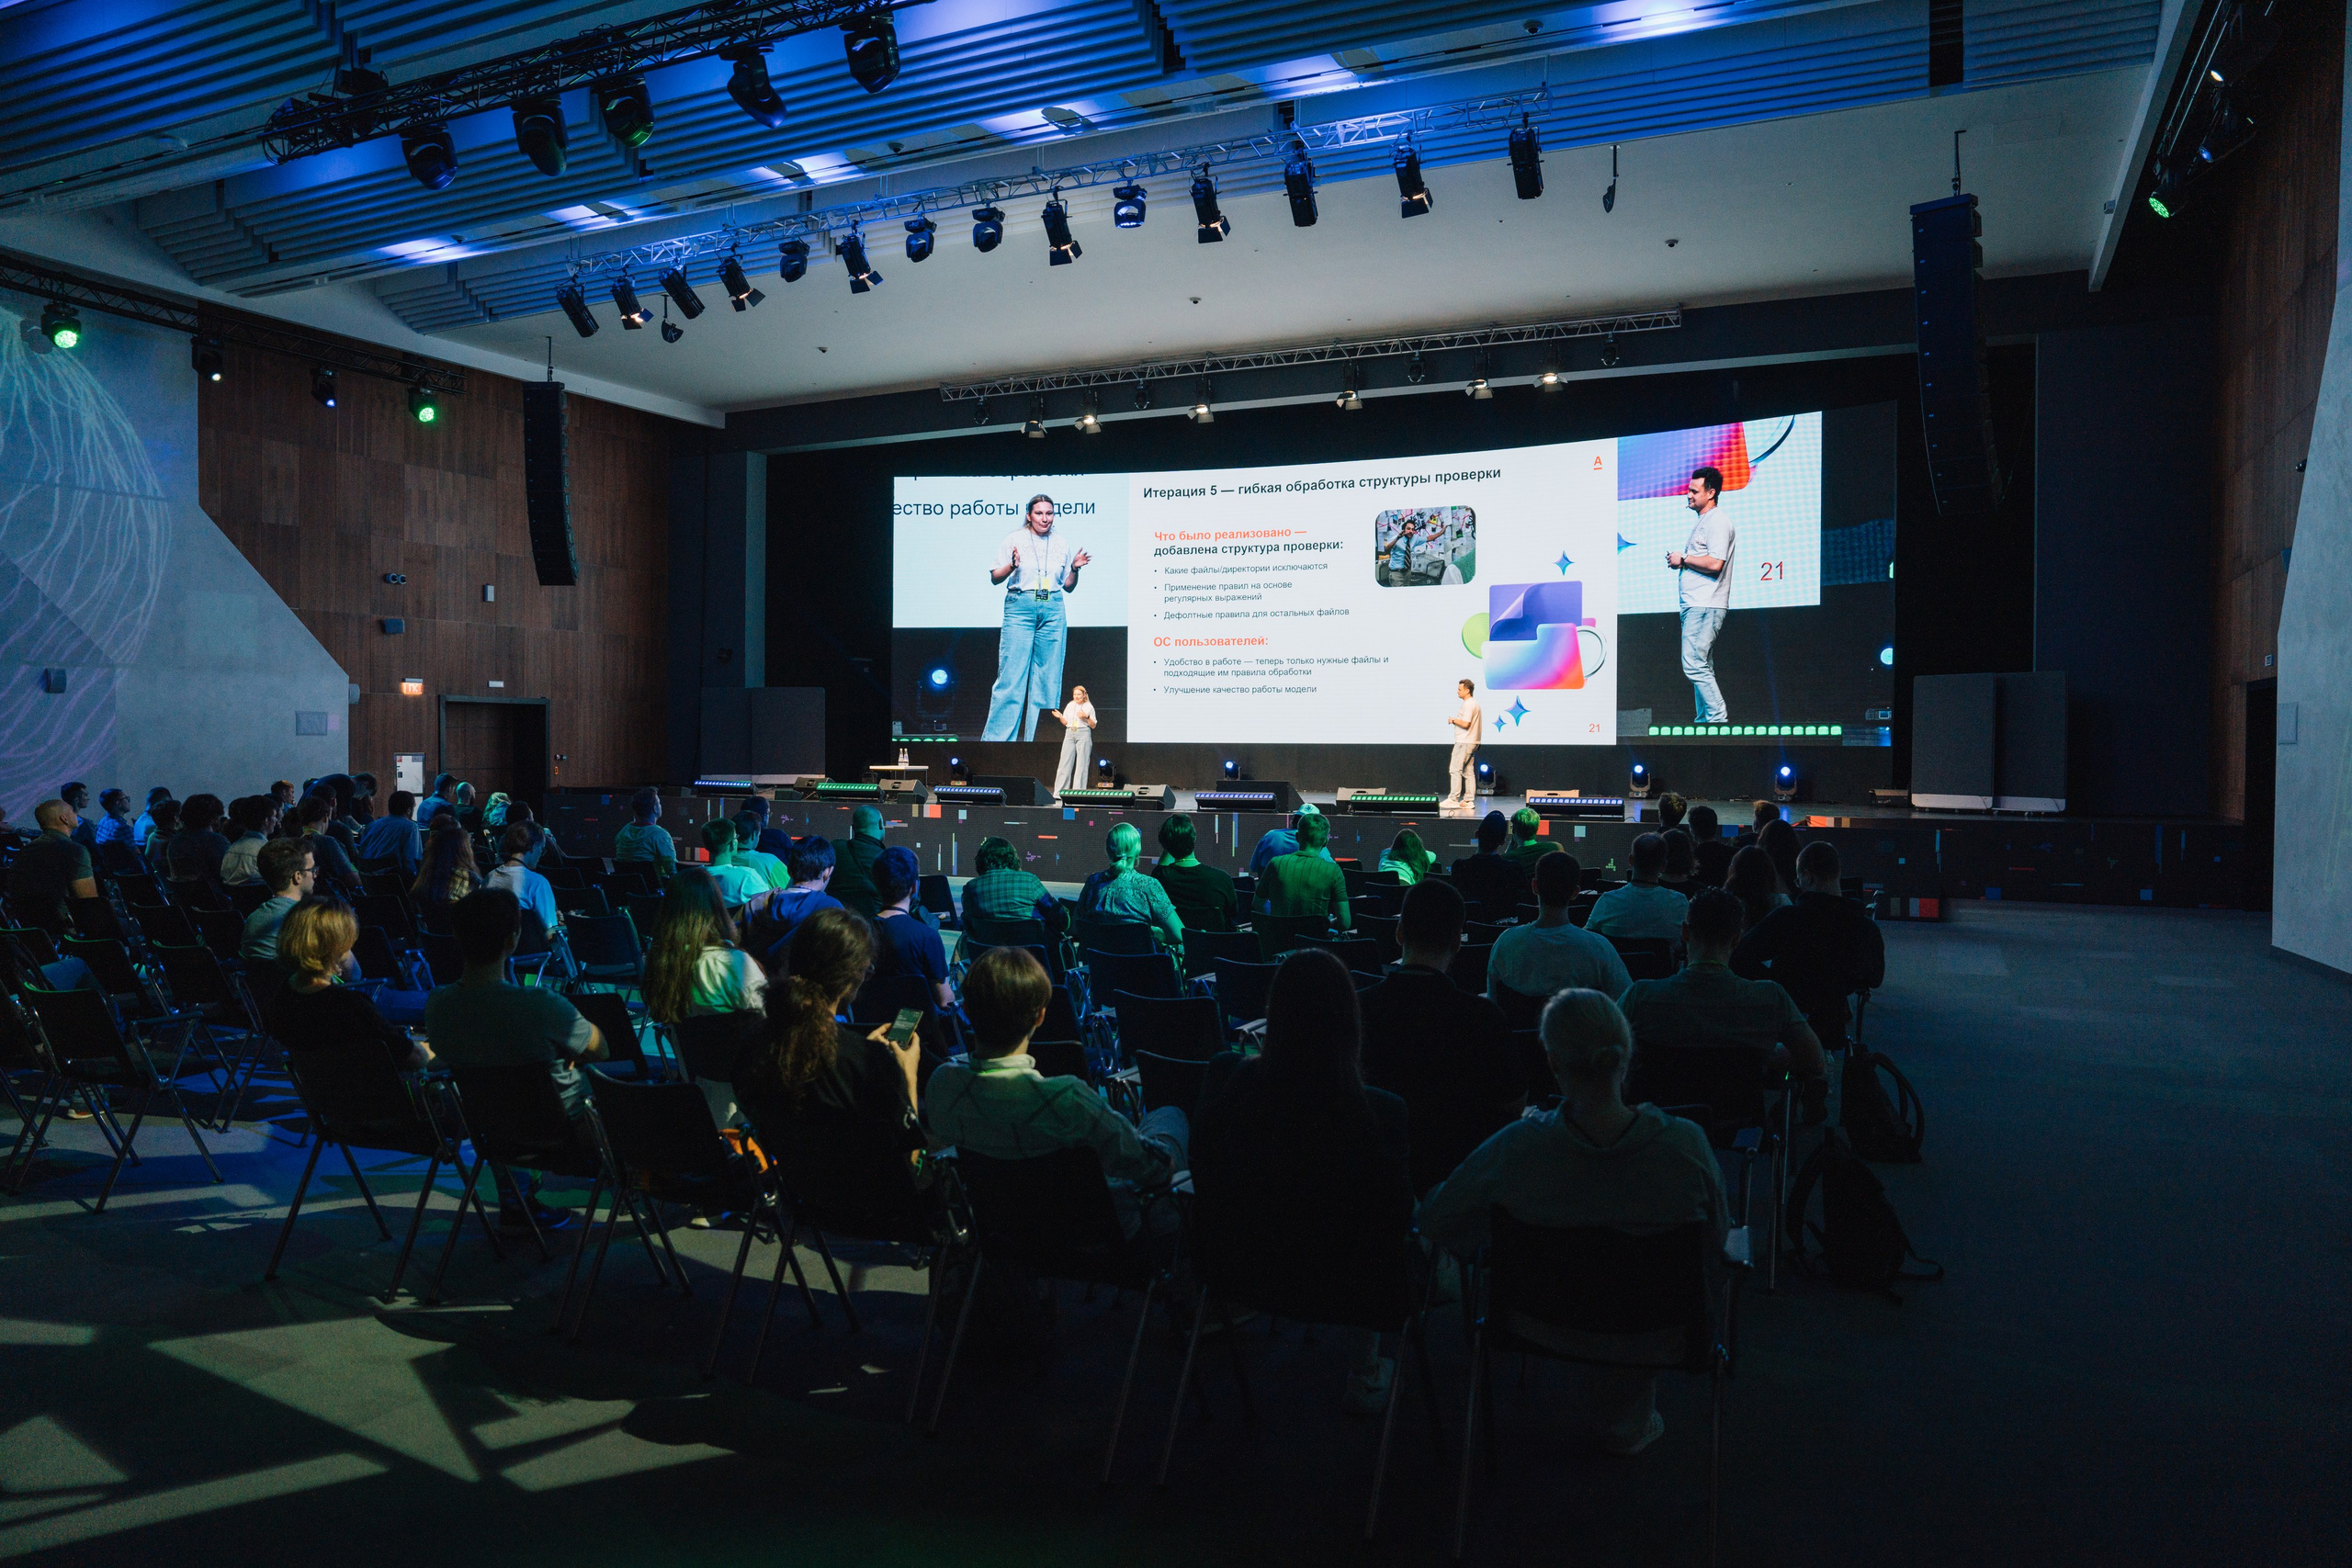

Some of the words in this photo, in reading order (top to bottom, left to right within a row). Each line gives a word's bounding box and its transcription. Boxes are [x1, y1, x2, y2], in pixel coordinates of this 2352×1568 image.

[1143, 487, 1206, 501] Итерация
[1210, 484, 1217, 496] 5
[1238, 482, 1282, 495] гибкая
[1285, 479, 1355, 494] обработка
[1359, 474, 1430, 490] структуры
[1435, 468, 1501, 485] проверки
[893, 501, 944, 516] ество
[950, 499, 1019, 520] работы
[1026, 502, 1095, 518] дели
[1154, 531, 1176, 542] Что
[1179, 530, 1212, 541] было
[1214, 528, 1292, 542] реализовано
[1153, 545, 1218, 558] добавлена
[1221, 544, 1280, 557] структура
[1283, 541, 1343, 554] проверки:
[1164, 566, 1189, 575] Какие
[1190, 565, 1271, 576] файлы/директории
[1272, 563, 1329, 571] исключаются
[1760, 560, 1783, 581] 21
[1164, 583, 1217, 593] Применение
[1218, 582, 1250, 592] правил
[1262, 581, 1293, 590] основе
[1164, 595, 1213, 604] регулярных
[1215, 592, 1262, 604] выражений
[1163, 611, 1214, 621] Дефолтные
[1215, 611, 1250, 620] правила
[1251, 611, 1268, 619] для
[1316, 607, 1350, 618] файлов
[1153, 636, 1171, 648] ОС
[1174, 636, 1269, 647] пользователей:
[1163, 657, 1204, 667] Удобство
[1212, 657, 1242, 668] работе
[1255, 658, 1284, 667] теперь
[1317, 657, 1350, 666] нужные
[1351, 655, 1381, 666] файлы
[1163, 670, 1216, 678] подходящие
[1230, 670, 1266, 678] правила
[1268, 667, 1312, 678] обработки
[1163, 685, 1211, 695] Улучшение
[1251, 684, 1283, 695] работы
[1284, 686, 1317, 694] модели
[1589, 723, 1600, 733] 21
